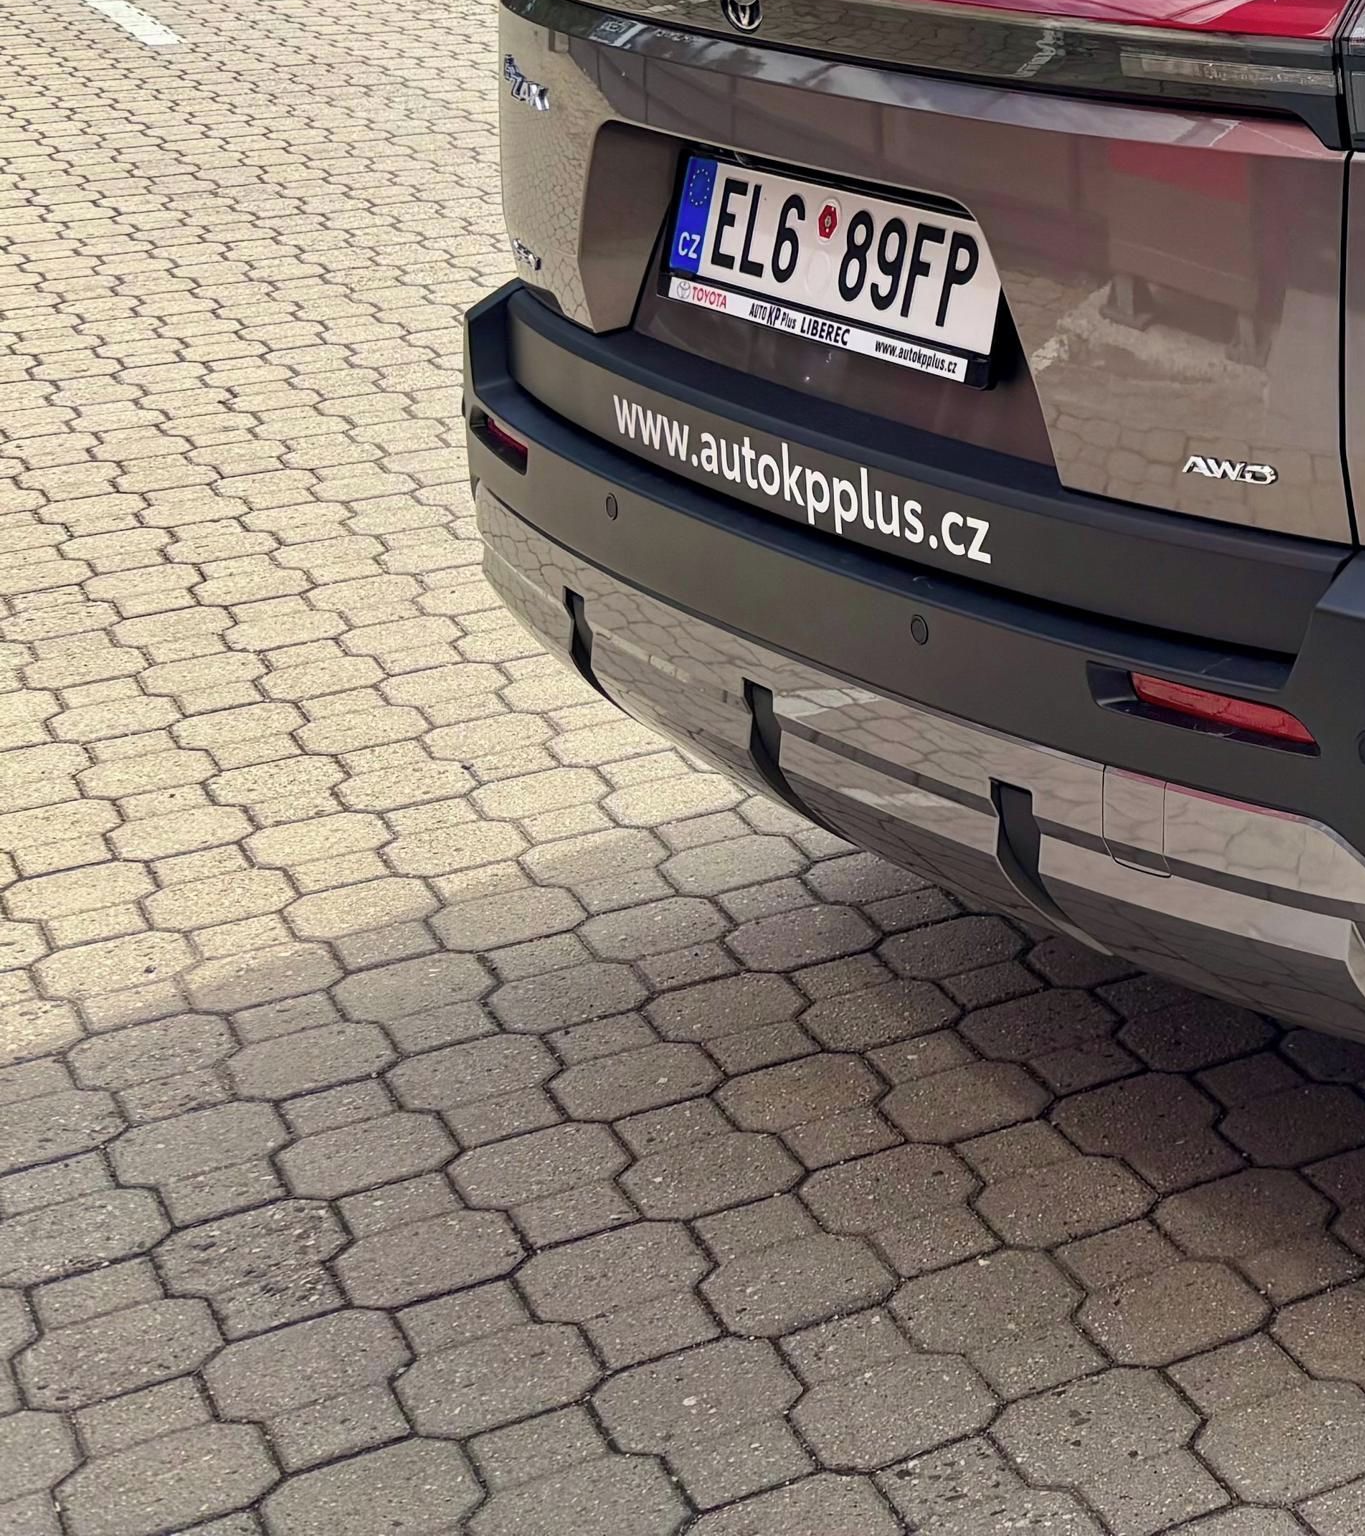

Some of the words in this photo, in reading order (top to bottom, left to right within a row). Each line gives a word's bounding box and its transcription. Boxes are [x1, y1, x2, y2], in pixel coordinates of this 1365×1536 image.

[677, 231, 702, 260] CZ
[710, 176, 807, 284] EL6
[837, 209, 980, 328] 89FP
[691, 286, 728, 310] TOYOTA
[780, 312, 798, 330] Plus
[799, 318, 851, 347] LIBEREC
[874, 338, 959, 375] www.autokpplus.cz
[612, 393, 993, 565] www.autokpplus.cz
[1181, 453, 1280, 486] AWD
